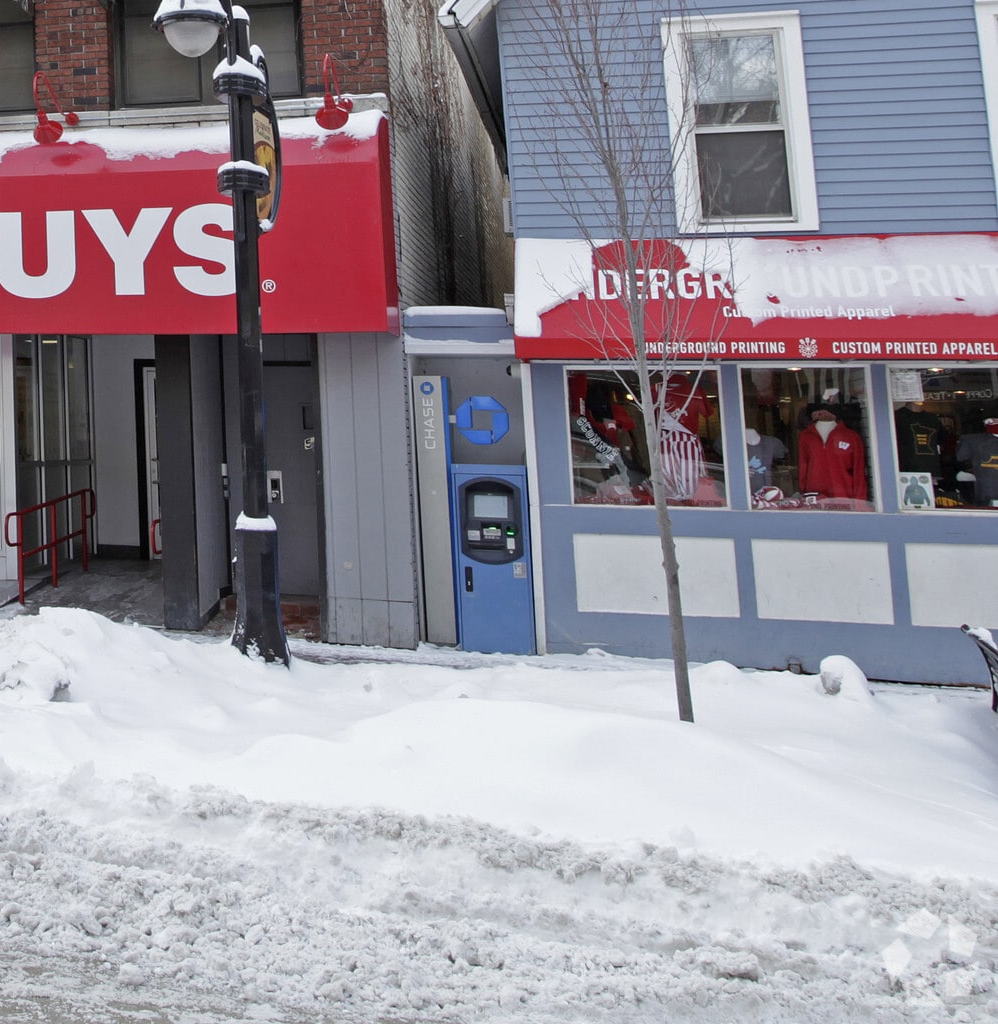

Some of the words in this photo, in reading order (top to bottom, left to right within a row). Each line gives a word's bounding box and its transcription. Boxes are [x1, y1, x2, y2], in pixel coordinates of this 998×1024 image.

[780, 305, 833, 318] Printed
[837, 305, 896, 321] Apparel
[642, 341, 727, 354] UNDERGROUND
[731, 342, 786, 354] PRINTING
[832, 342, 881, 355] CUSTOM
[886, 342, 938, 355] PRINTED
[942, 343, 998, 356] APPAREL
[422, 398, 436, 450] CHASE
